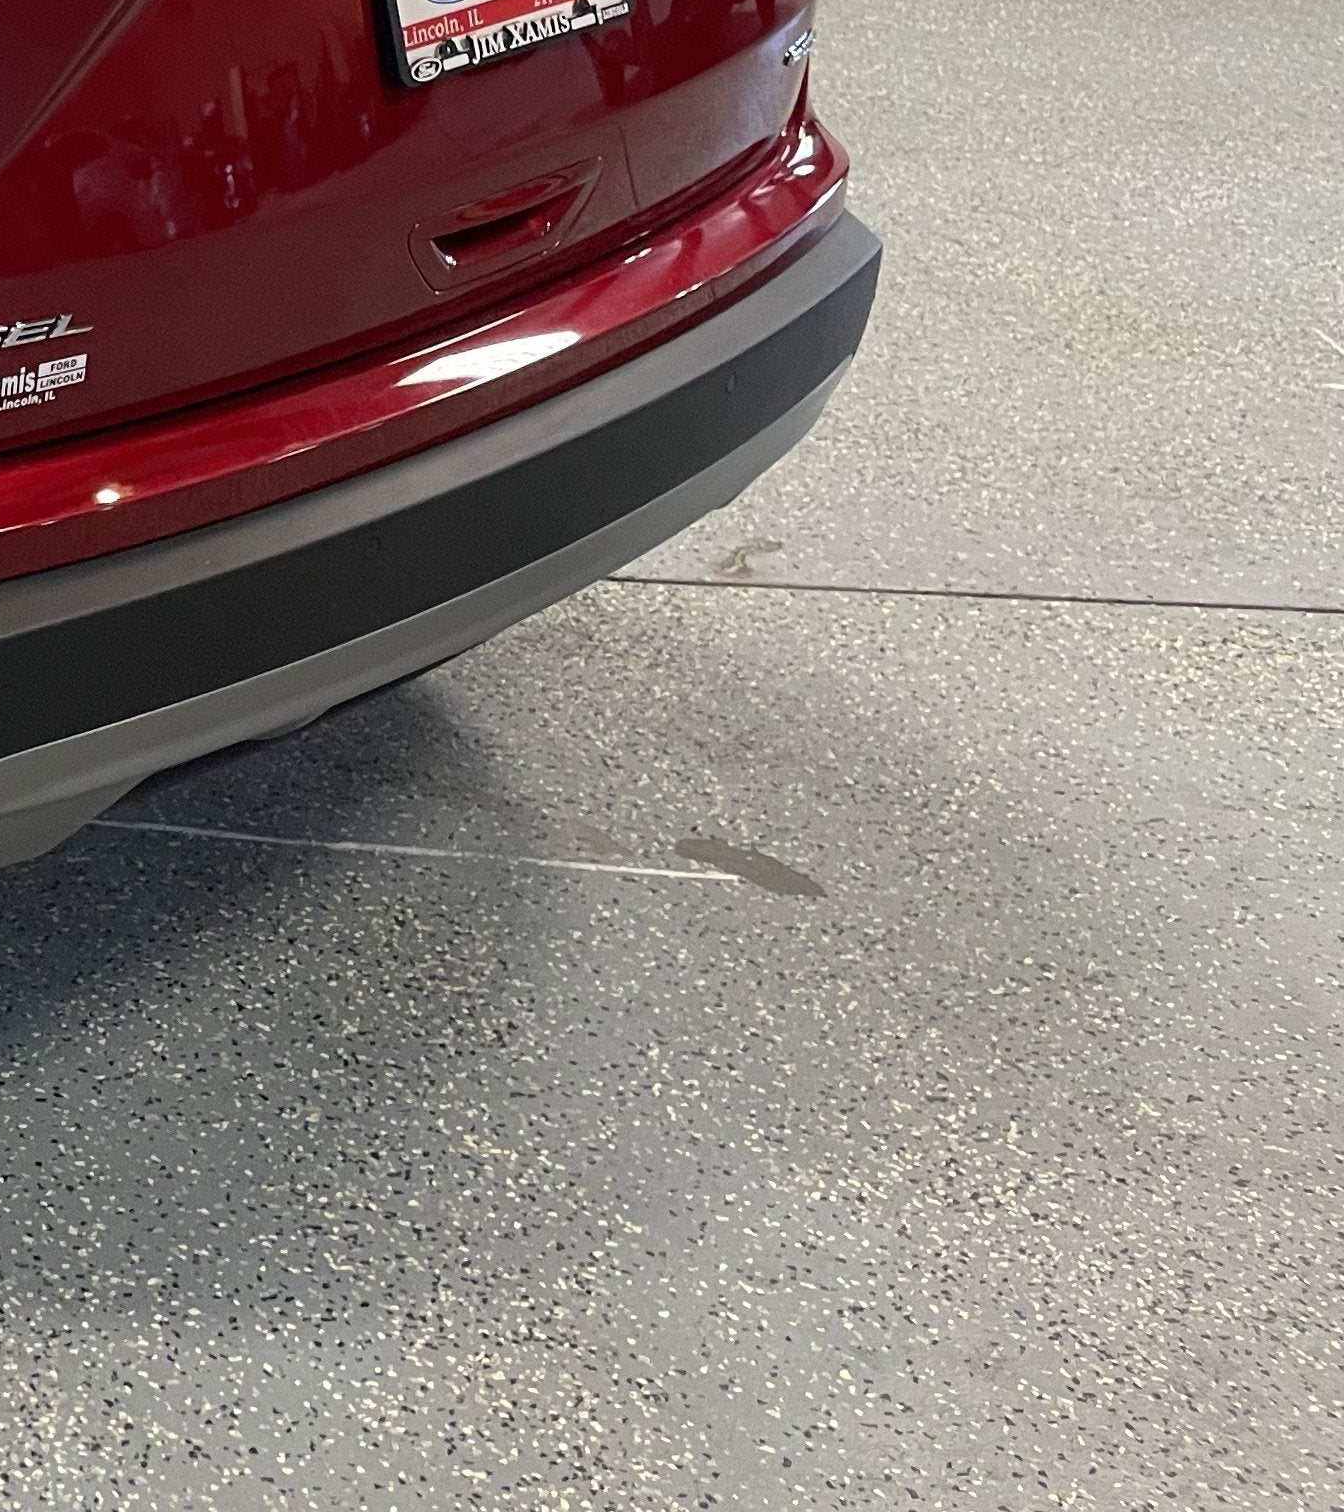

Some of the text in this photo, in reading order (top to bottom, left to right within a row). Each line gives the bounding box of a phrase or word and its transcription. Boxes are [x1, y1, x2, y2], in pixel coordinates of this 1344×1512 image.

[403, 8, 484, 48] Lincoln, IL
[469, 33, 506, 65] JIM
[507, 14, 571, 49] XAMIS
[50, 359, 78, 372] FORD
[39, 371, 84, 389] LINCOLN
[44, 391, 56, 402] IL
